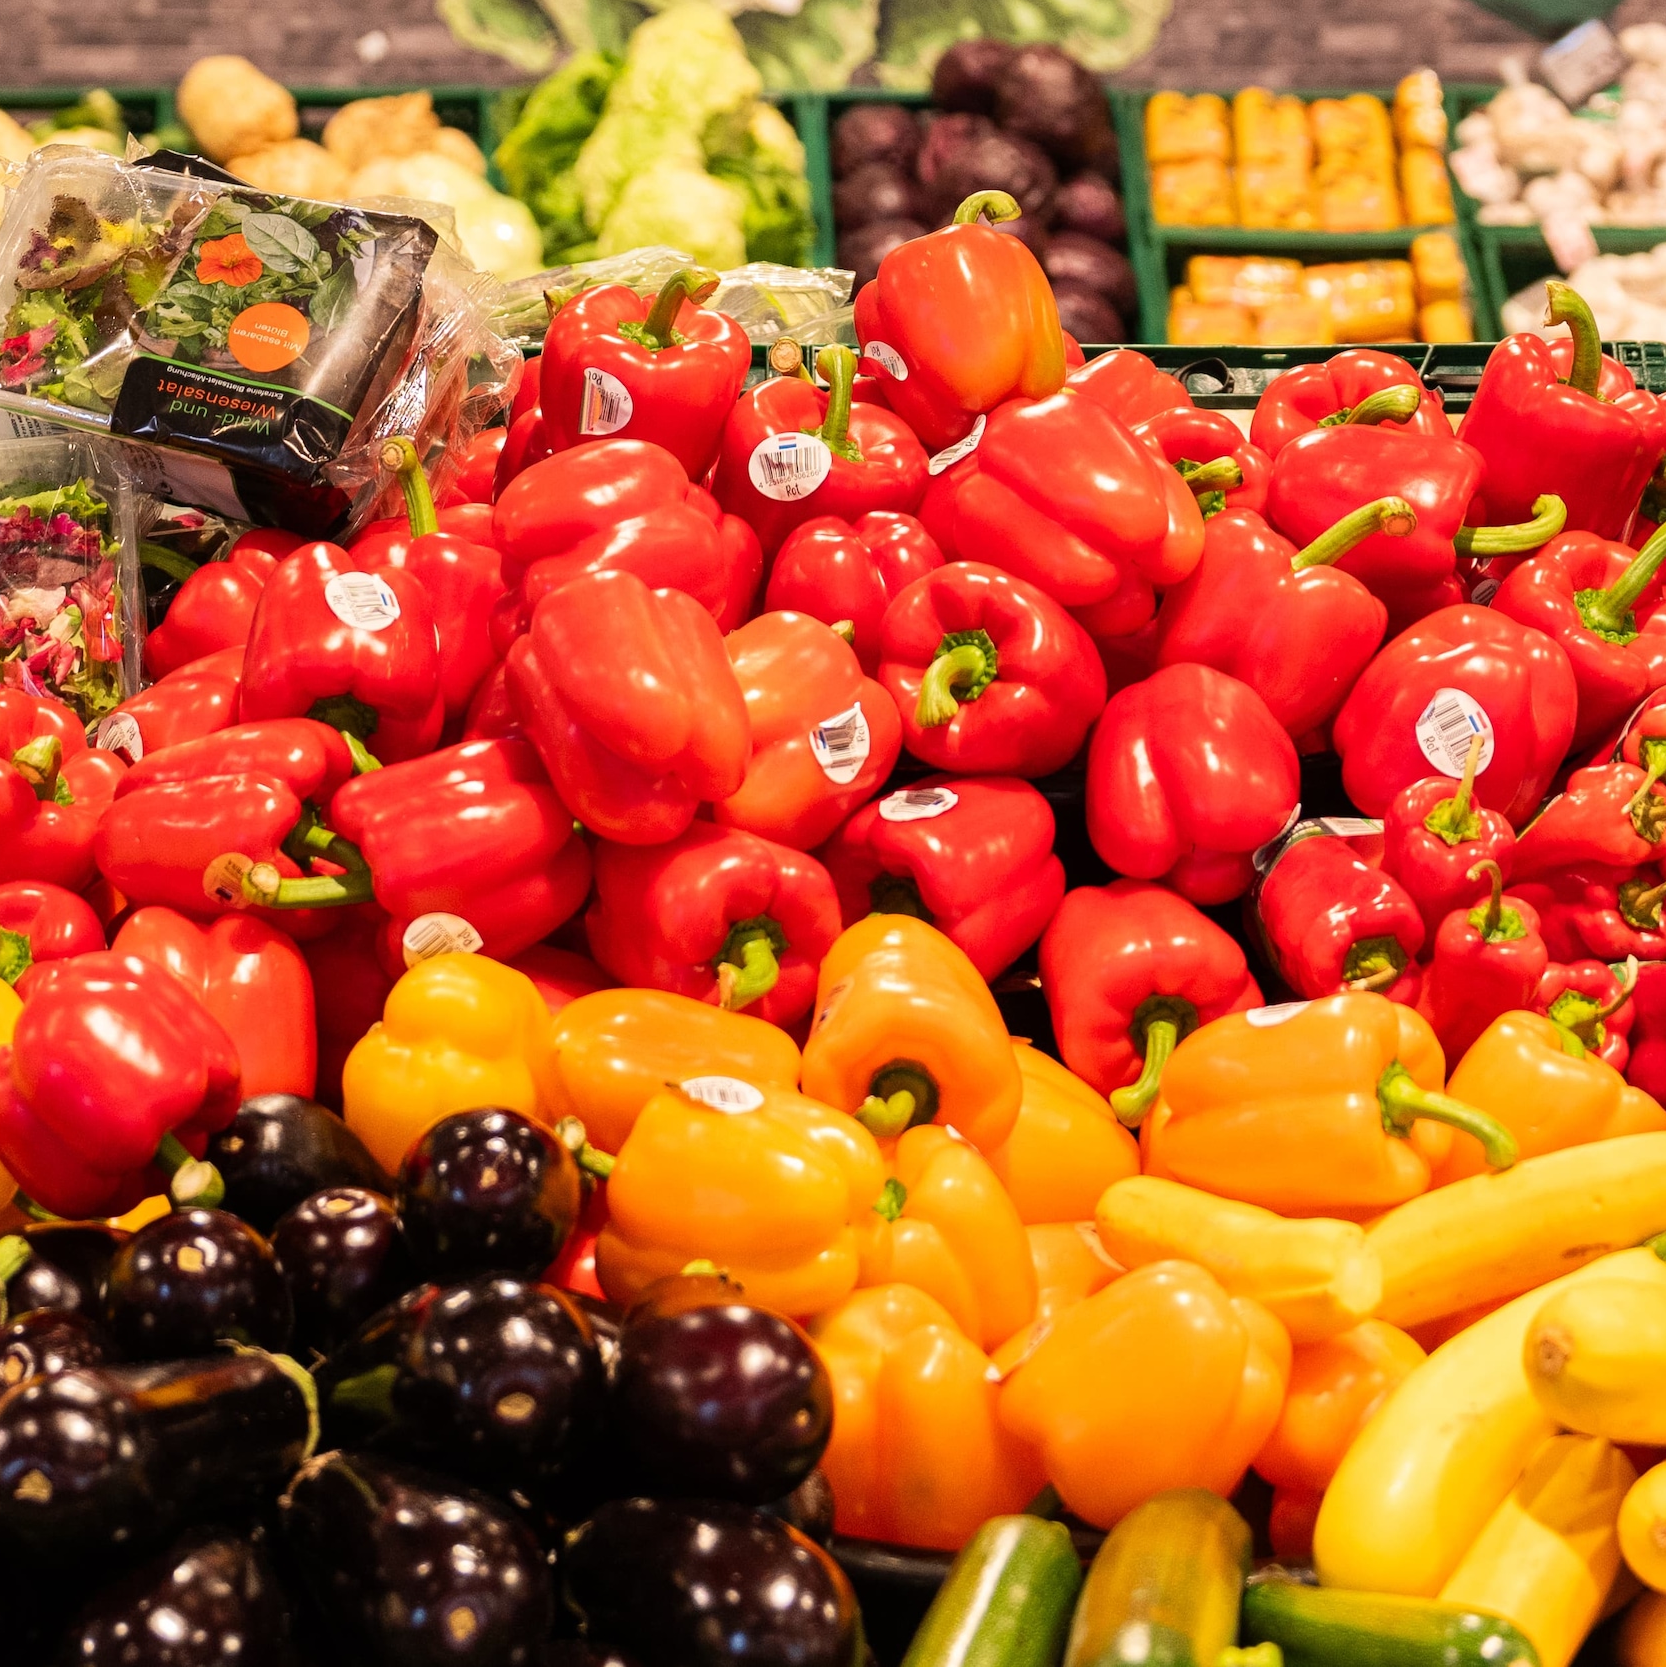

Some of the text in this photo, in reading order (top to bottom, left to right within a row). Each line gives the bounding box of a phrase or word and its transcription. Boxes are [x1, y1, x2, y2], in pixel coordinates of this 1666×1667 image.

[233, 328, 302, 353] Mit essbaren
[166, 365, 284, 400] Extrafeine Blattsalat-Mischung
[157, 379, 276, 420] Wiesensalat
[169, 399, 270, 435] Wald- und
[785, 484, 801, 497] Rot
[1423, 735, 1440, 756] Rot
